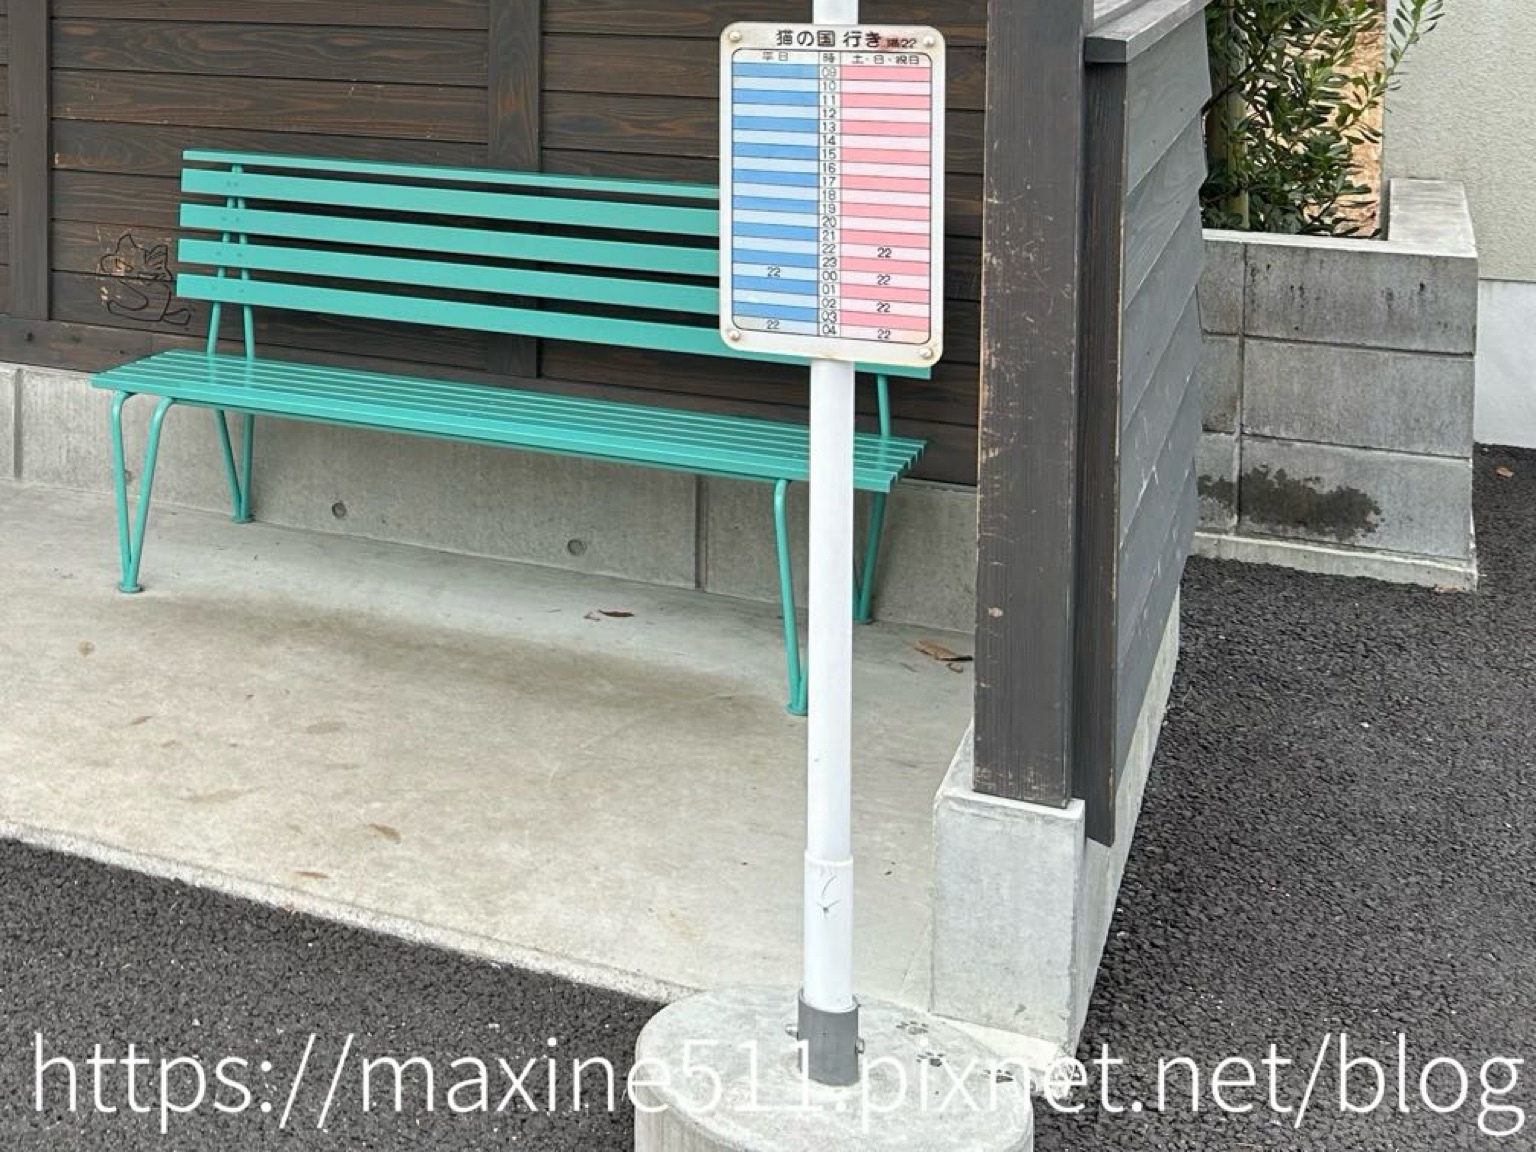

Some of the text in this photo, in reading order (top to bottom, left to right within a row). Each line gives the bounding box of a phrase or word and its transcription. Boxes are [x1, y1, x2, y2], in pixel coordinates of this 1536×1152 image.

[776, 29, 836, 47] 猫の国
[842, 30, 882, 48] 行き
[762, 51, 789, 62] 平日
[823, 81, 836, 91] 10
[823, 95, 836, 105] 11
[823, 108, 836, 118] 12
[823, 122, 836, 132] 13
[823, 135, 836, 145] 14
[823, 149, 836, 159] 15
[823, 162, 836, 173] 16
[823, 177, 836, 187] 17
[823, 190, 836, 201] 18
[823, 204, 836, 214] 19
[822, 216, 837, 227] 20
[822, 230, 835, 240] 21
[822, 243, 892, 258] 22 22
[822, 257, 837, 268] 23
[767, 267, 891, 285] 22 00 22
[822, 284, 836, 295] 01
[822, 298, 891, 313] 02 22
[767, 320, 891, 339] 22 04 22
